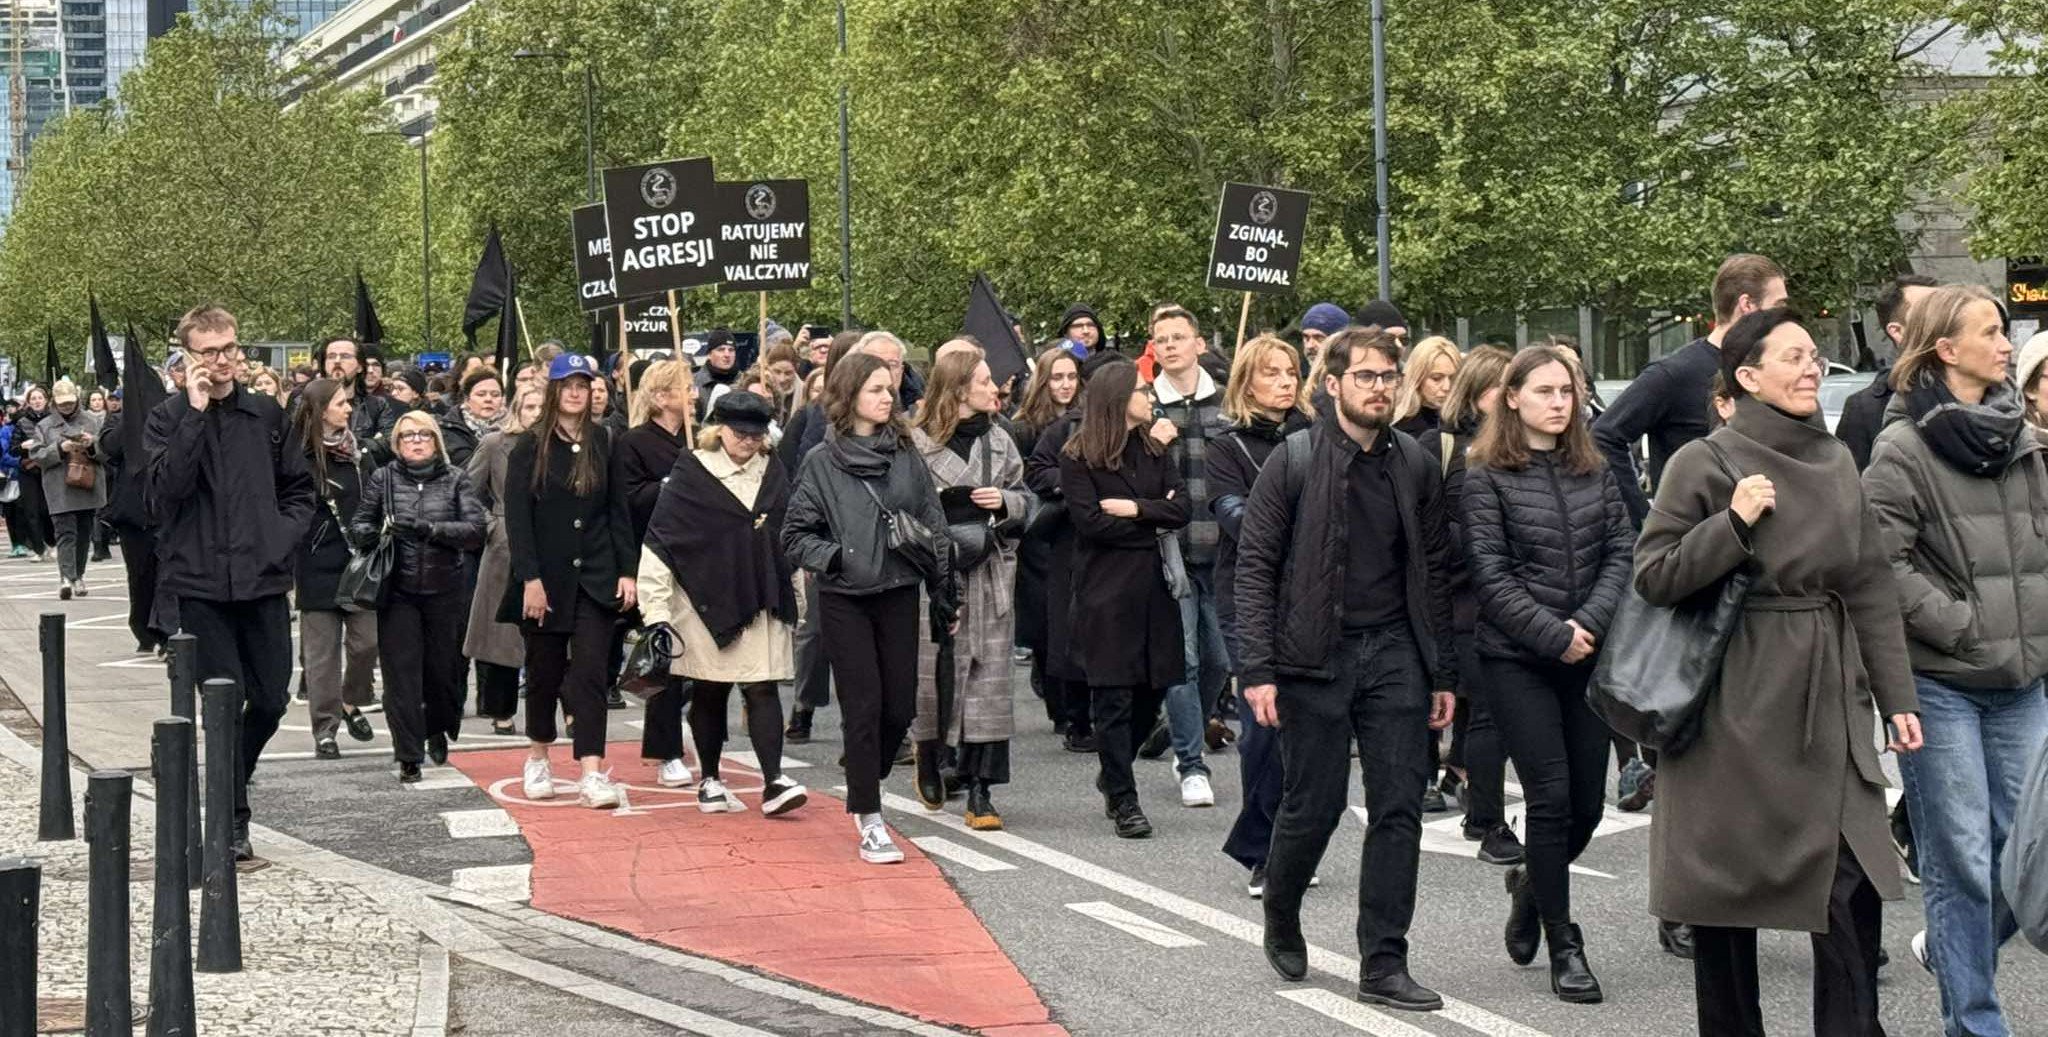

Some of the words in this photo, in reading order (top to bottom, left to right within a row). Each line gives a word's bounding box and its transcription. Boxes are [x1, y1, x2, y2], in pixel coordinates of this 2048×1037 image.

[634, 211, 695, 240] STOP
[721, 222, 806, 243] RATUJEMY
[1228, 223, 1289, 249] ZGINĄŁ,
[621, 237, 714, 272] AGRESJI
[750, 244, 778, 260] NIE
[1244, 246, 1268, 263] BO
[1215, 262, 1291, 286] RATOWAŁ
[623, 318, 668, 332] DYŻUR
